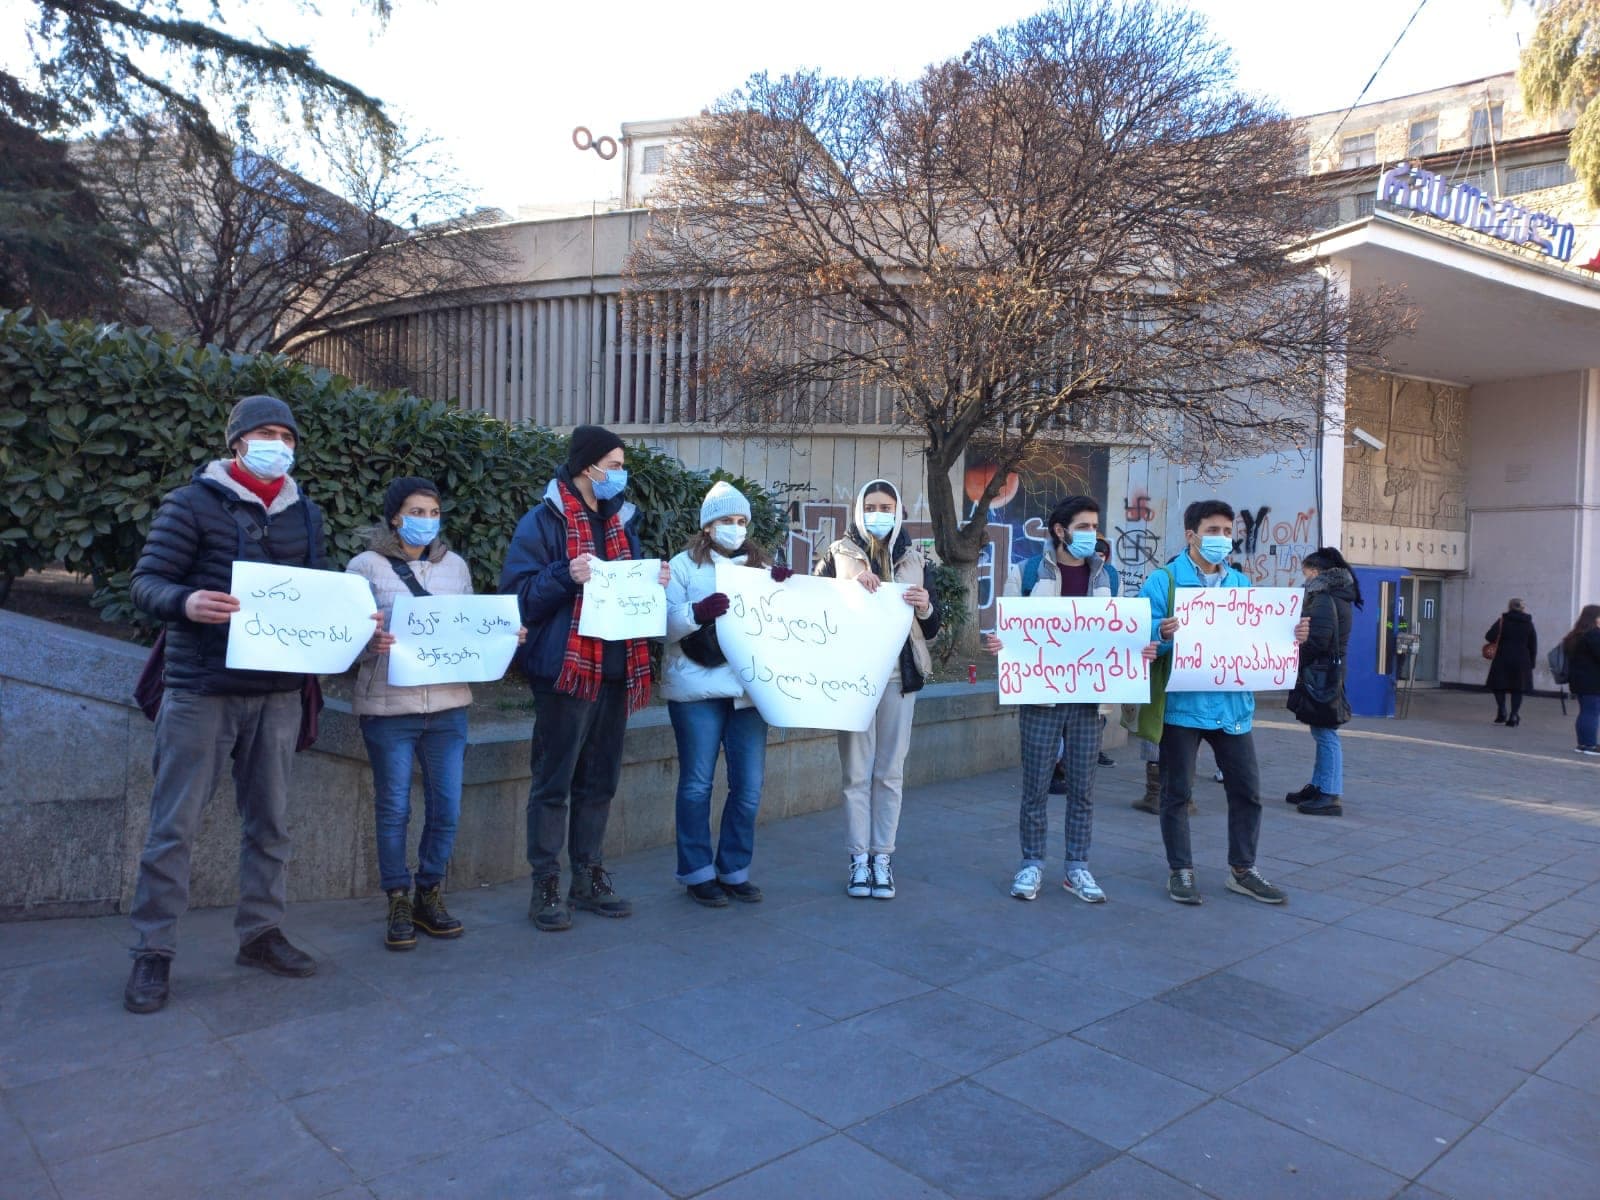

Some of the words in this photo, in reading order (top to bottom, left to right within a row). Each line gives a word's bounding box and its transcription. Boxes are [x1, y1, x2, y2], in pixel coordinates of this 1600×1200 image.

[1377, 162, 1575, 262] რუსთაველი
[250, 577, 301, 602] არა
[407, 611, 441, 636] ჩვენ
[452, 611, 470, 625] არ
[476, 615, 512, 635] ვართ
[998, 599, 1138, 648] სოლიდარობა
[999, 646, 1149, 694] გვაძლიერებს!
[1174, 641, 1203, 675] რომ
